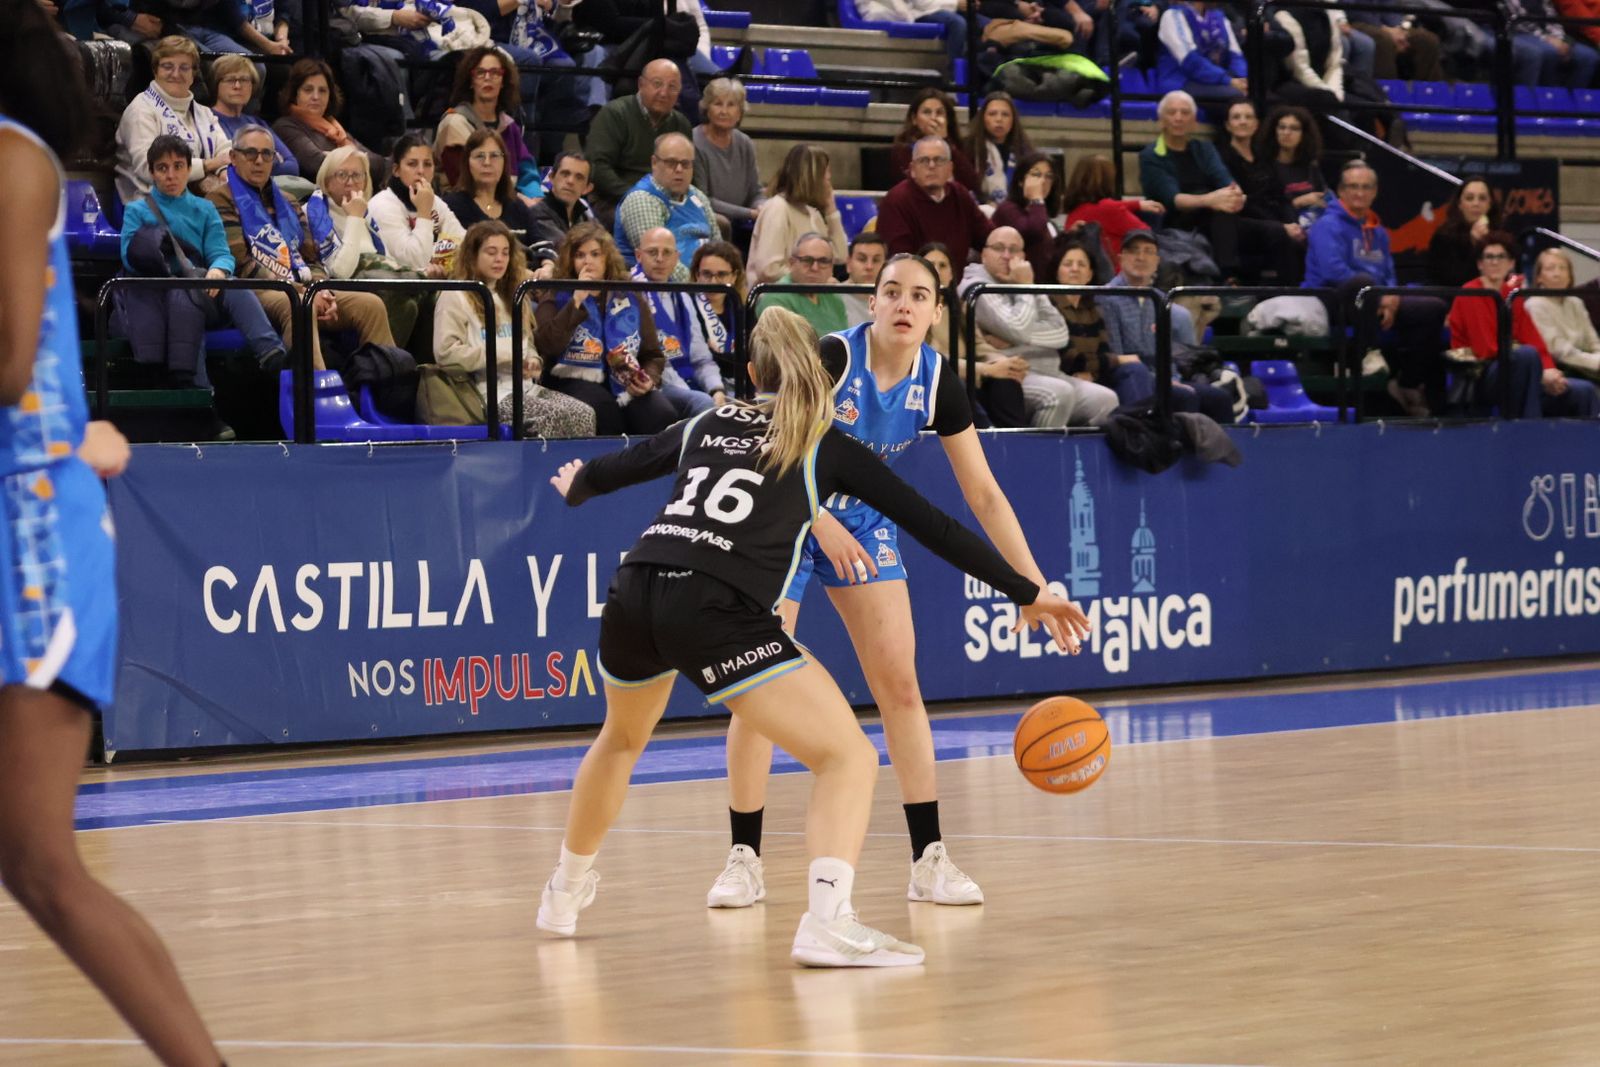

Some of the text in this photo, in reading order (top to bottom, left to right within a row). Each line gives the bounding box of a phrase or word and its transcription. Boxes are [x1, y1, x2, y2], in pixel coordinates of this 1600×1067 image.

[700, 434, 753, 448] MGS
[663, 466, 765, 524] 16
[202, 552, 630, 637] CASTILLA Y L
[348, 649, 596, 714] NOS IMPULSA
[720, 641, 783, 675] MADRID
